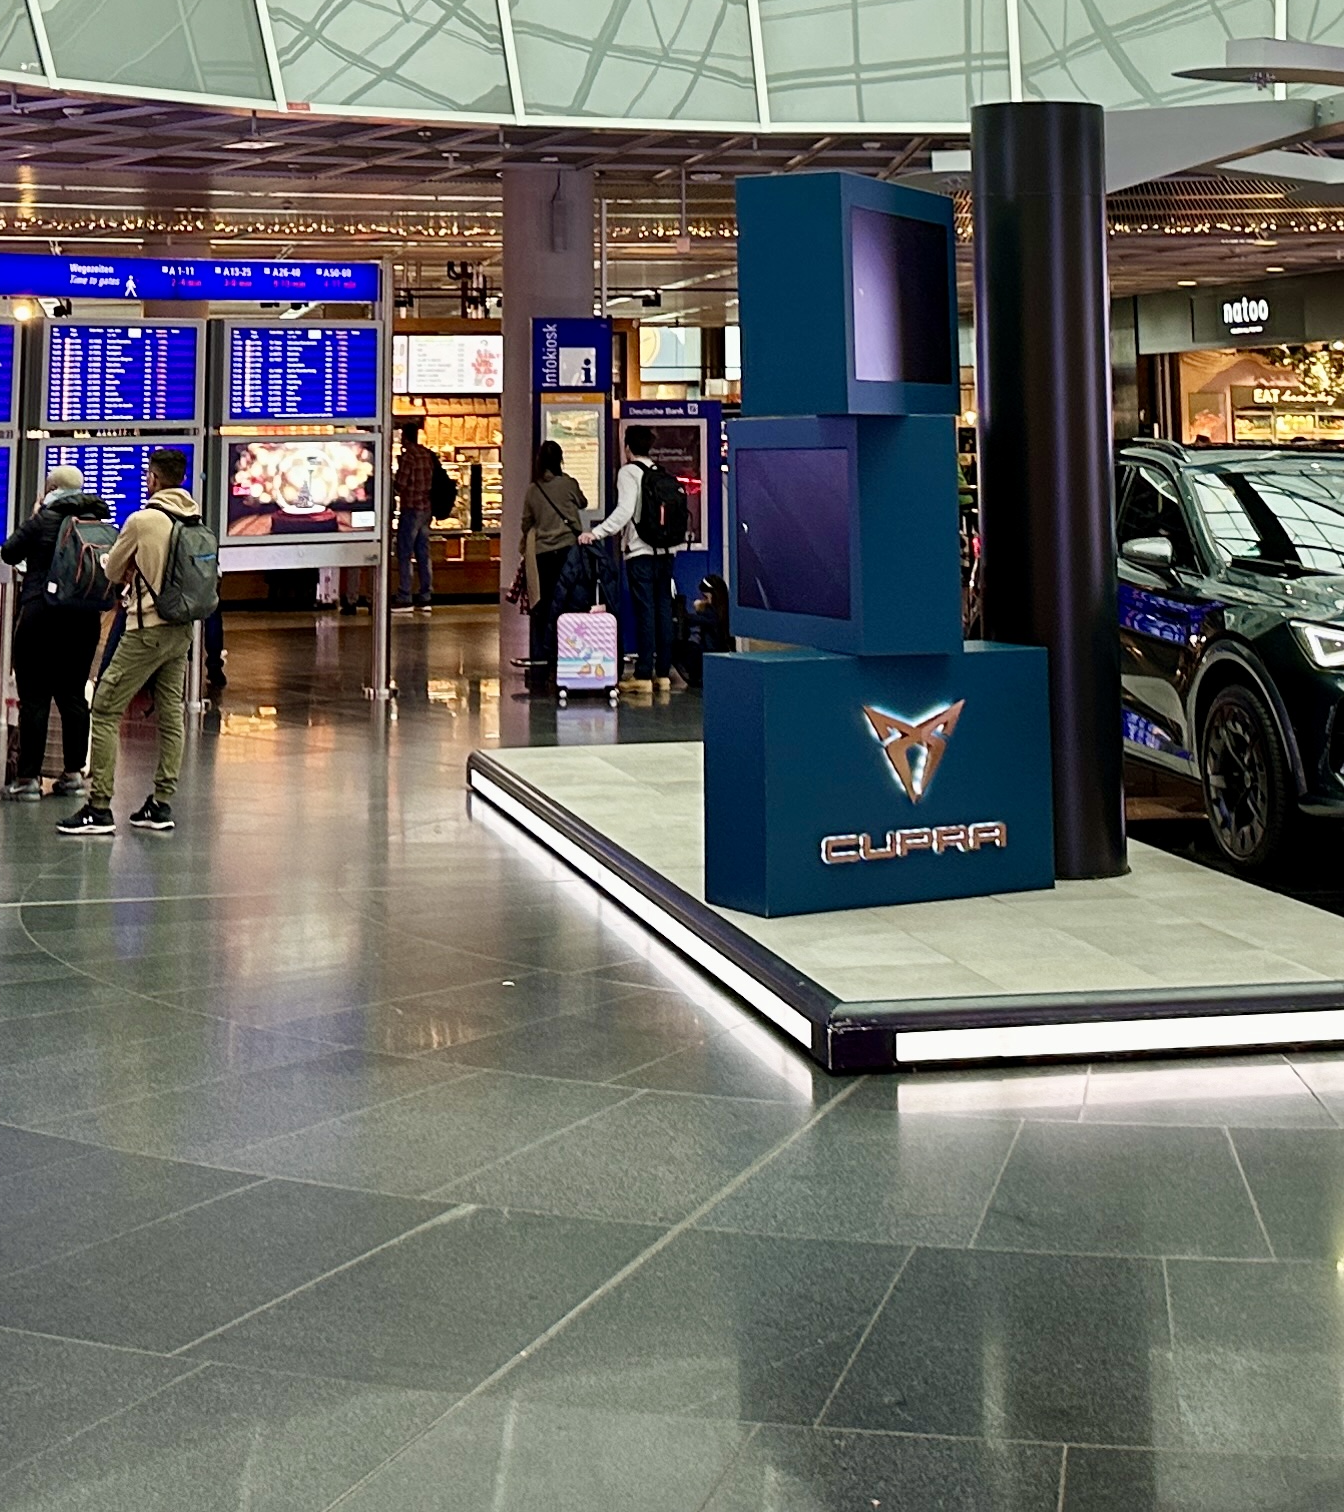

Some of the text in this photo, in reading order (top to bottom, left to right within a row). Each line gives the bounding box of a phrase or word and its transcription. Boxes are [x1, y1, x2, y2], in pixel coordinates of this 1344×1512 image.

[1223, 296, 1269, 324] natoo
[541, 323, 558, 387] Infokiosk
[1253, 388, 1281, 404] EAT
[628, 407, 685, 416] Deutsche Bank
[820, 821, 1007, 865] CUPRA
